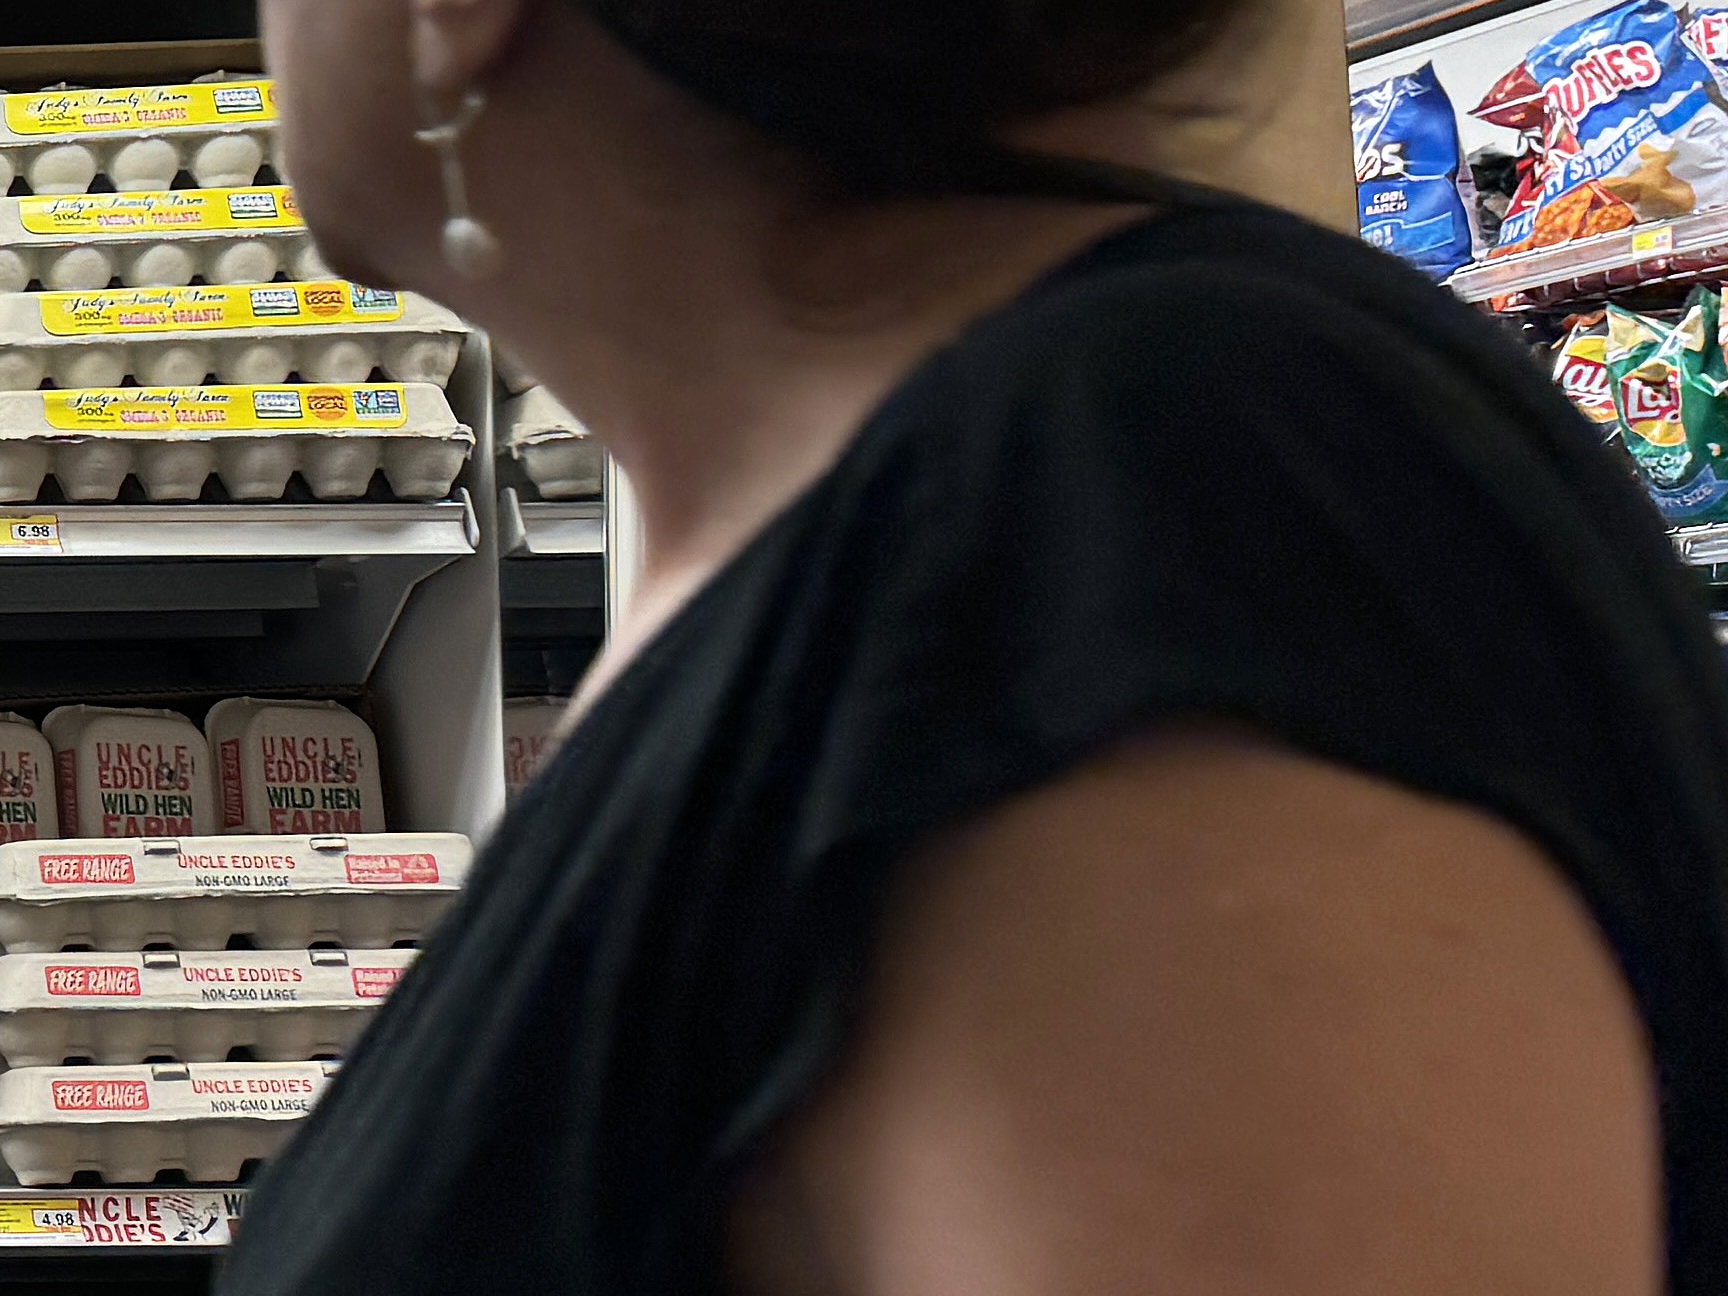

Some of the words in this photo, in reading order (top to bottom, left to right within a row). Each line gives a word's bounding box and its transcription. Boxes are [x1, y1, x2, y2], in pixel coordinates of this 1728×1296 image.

[17, 524, 51, 539] 6.98
[101, 793, 149, 815] WILD
[154, 794, 192, 817] HEN
[267, 786, 315, 809] WILD
[321, 787, 360, 809] HEN
[43, 858, 78, 881] FREE
[83, 858, 132, 881] RANGE
[177, 854, 226, 869] UNCLE
[232, 854, 295, 869] EDDIE'S
[49, 968, 84, 993] FREE
[88, 967, 137, 993] RANGE
[183, 968, 235, 982] UNCLE
[238, 968, 302, 982] EDDIE'S
[56, 1083, 93, 1108] FREE
[95, 1083, 145, 1109] RANGE
[193, 1079, 244, 1094] UNCLE
[248, 1079, 312, 1093] EDDIE'S
[79, 1196, 160, 1222] NCLE
[85, 1223, 166, 1243] DDIE'S
